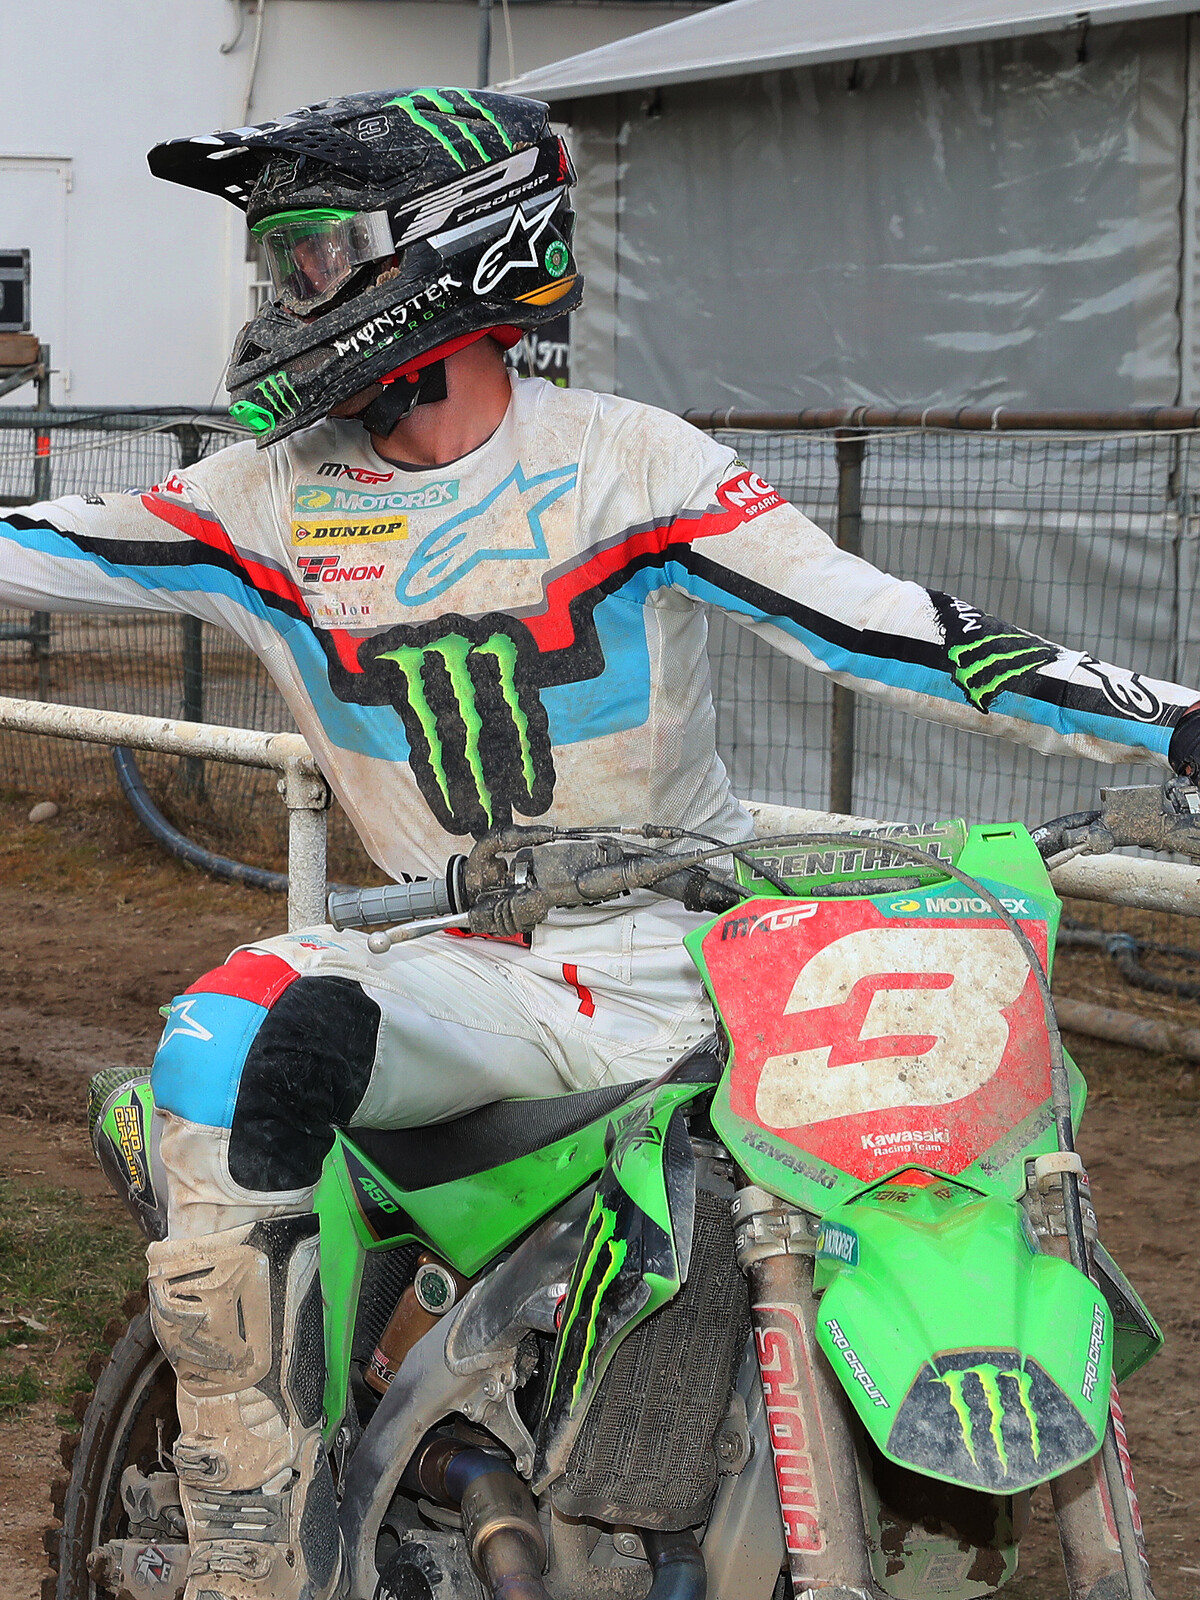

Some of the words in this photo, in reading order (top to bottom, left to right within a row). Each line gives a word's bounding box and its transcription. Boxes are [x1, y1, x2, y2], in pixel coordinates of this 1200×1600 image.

[358, 115, 391, 141] 3
[456, 173, 551, 223] PROGRIP
[331, 273, 463, 357] MONSTER
[316, 462, 395, 485] MXGP
[333, 482, 453, 511] MOTOREX
[313, 522, 402, 539] DUNLOP
[298, 555, 385, 583] TONON
[752, 842, 953, 880] RENTHAL
[721, 902, 819, 941] MXGP
[756, 928, 1034, 1130] 3
[125, 1106, 142, 1153] PRO
[861, 1128, 950, 1150] Kawasaki
[741, 1130, 839, 1191] Kawasaki
[873, 1145, 911, 1157] Racing
[912, 1144, 942, 1154] Team
[357, 1176, 399, 1214] 450
[823, 1228, 856, 1263] MOTOREX
[1090, 1303, 1107, 1366] CIRCUIT
[824, 1319, 850, 1348] PRO
[843, 1346, 890, 1409] CIRCUIT
[1082, 1366, 1099, 1402] PRO
[754, 1325, 825, 1554] SHOWA
